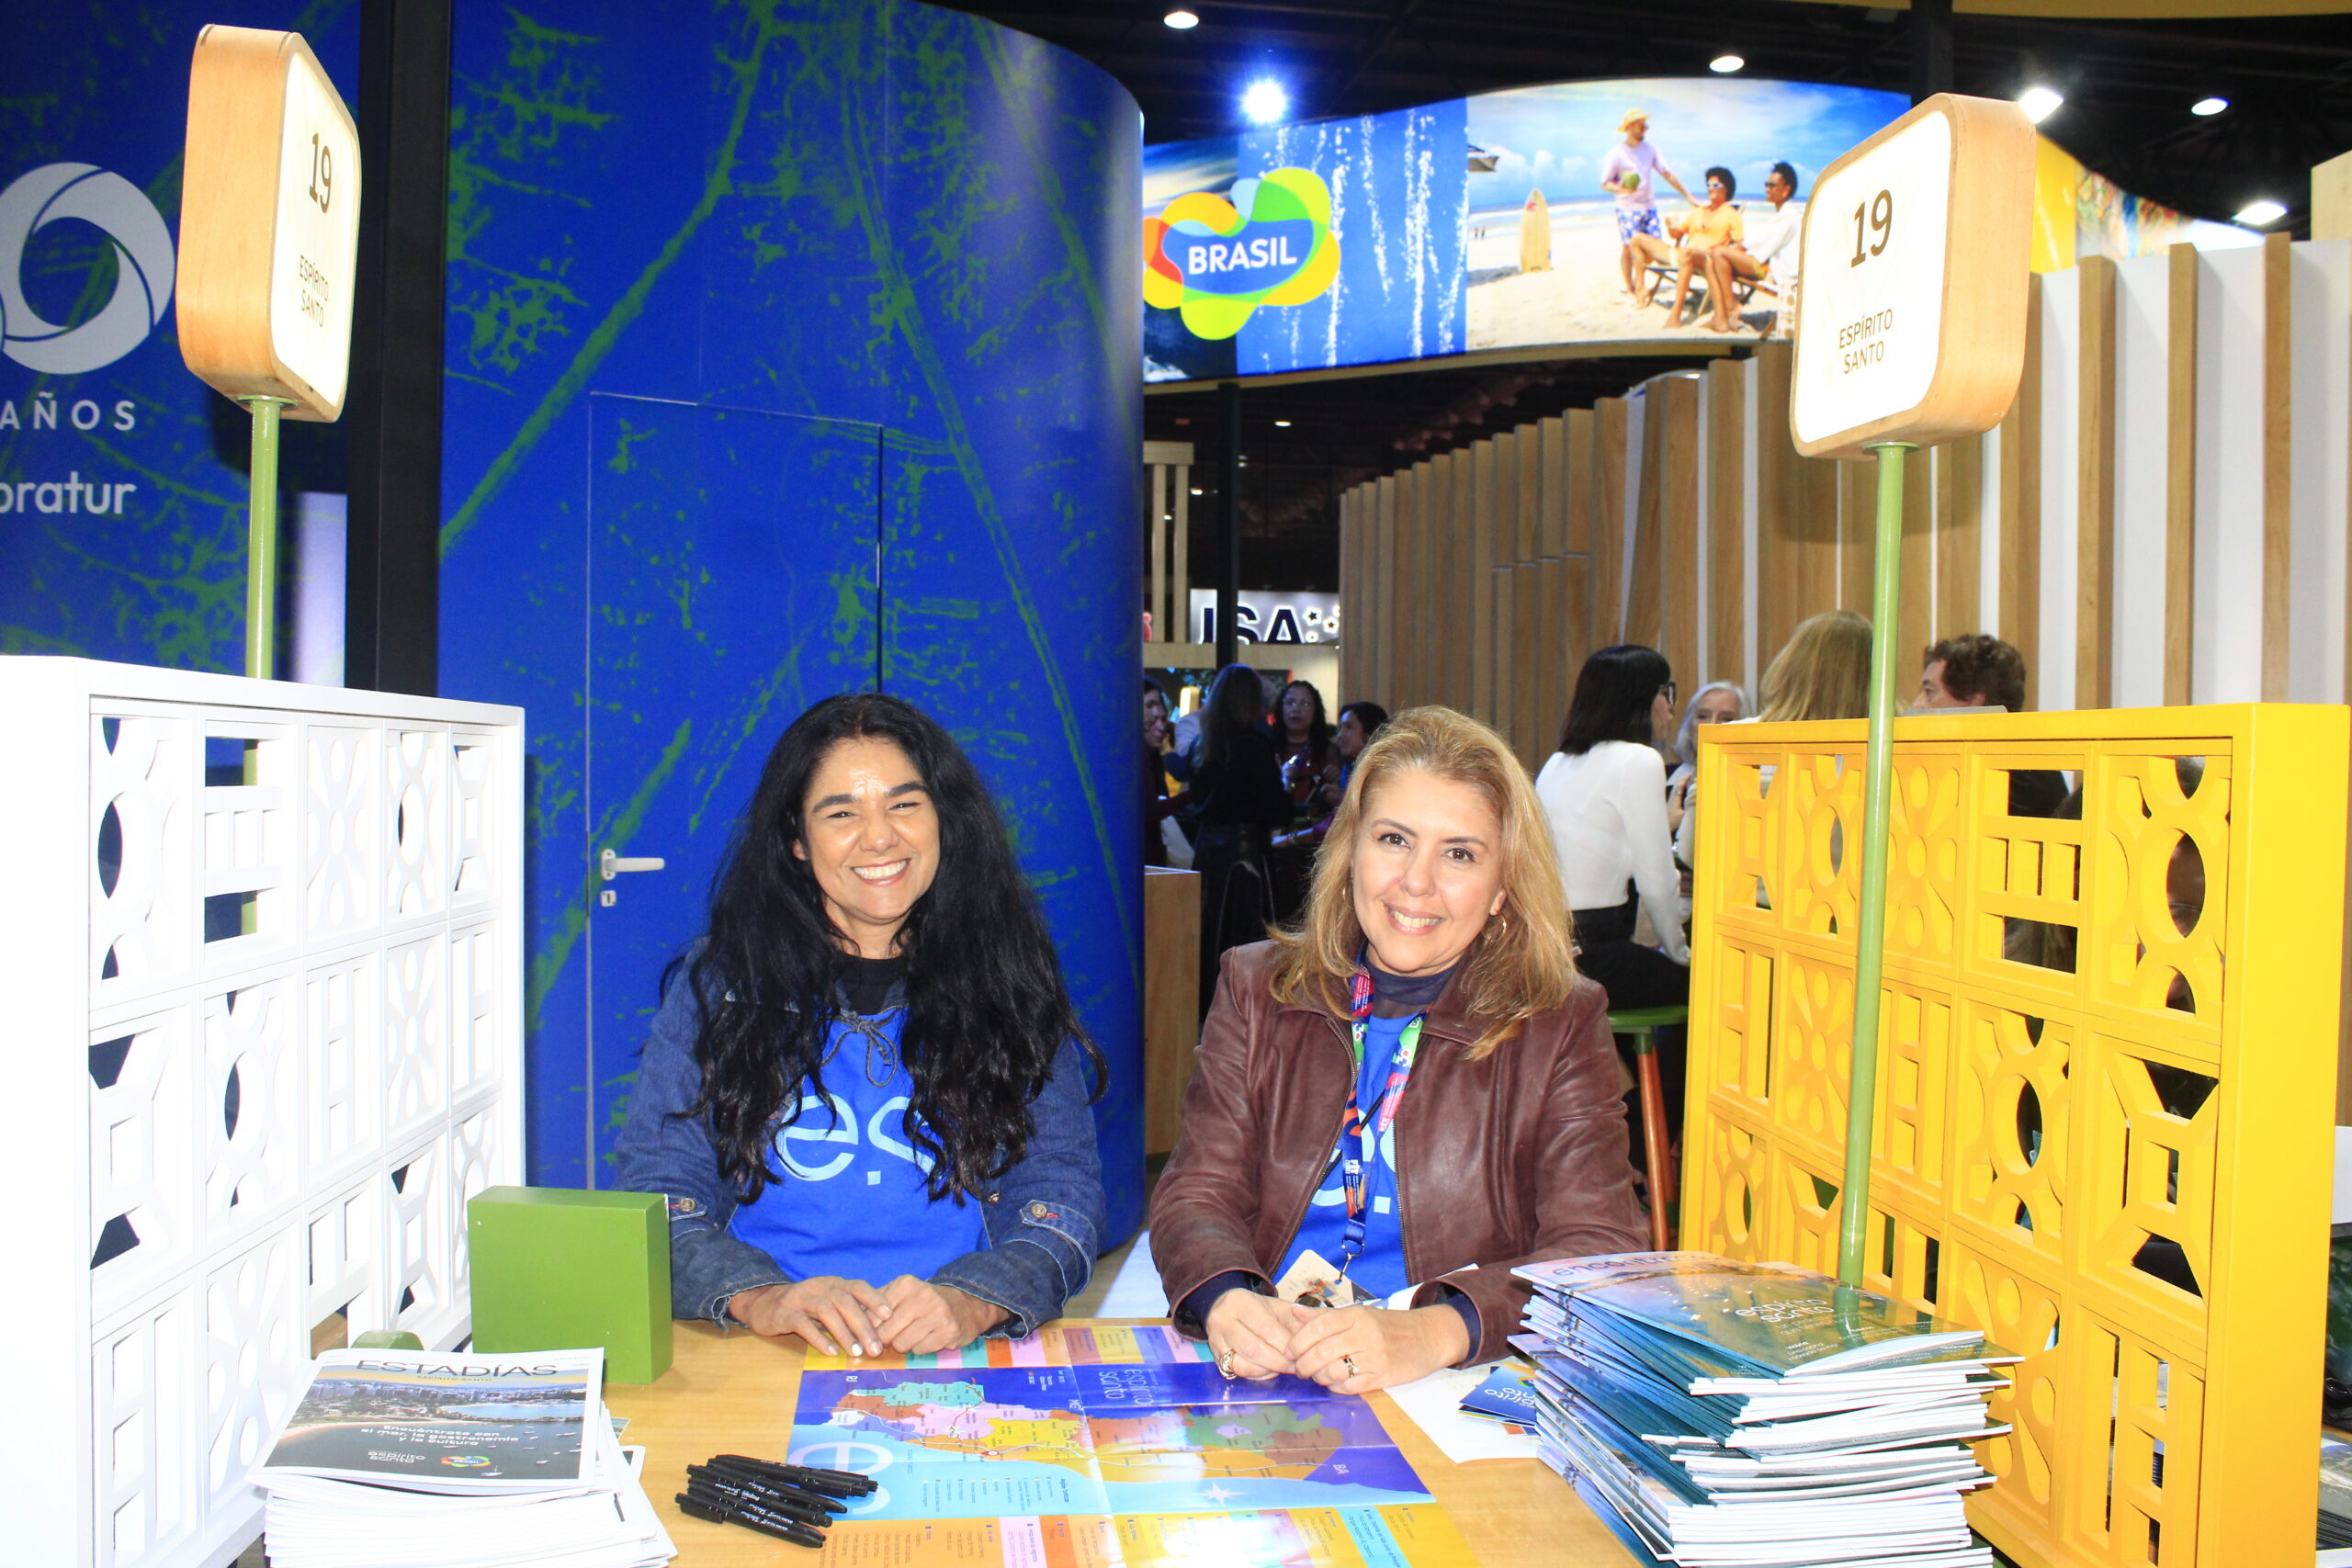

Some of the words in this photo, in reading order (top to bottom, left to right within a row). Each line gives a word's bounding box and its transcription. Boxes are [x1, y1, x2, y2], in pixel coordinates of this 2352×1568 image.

[310, 133, 332, 213] 19
[1850, 189, 1894, 267] 19
[1189, 236, 1297, 275] BRASIL
[300, 254, 329, 302] ESPÍRITO
[301, 289, 325, 328] SANTO
[1838, 308, 1894, 350] ESPÍRITO
[1843, 340, 1885, 375] SANTO
[0, 391, 135, 431] AÑOS
[356, 1359, 558, 1377] ESTADÍAS
